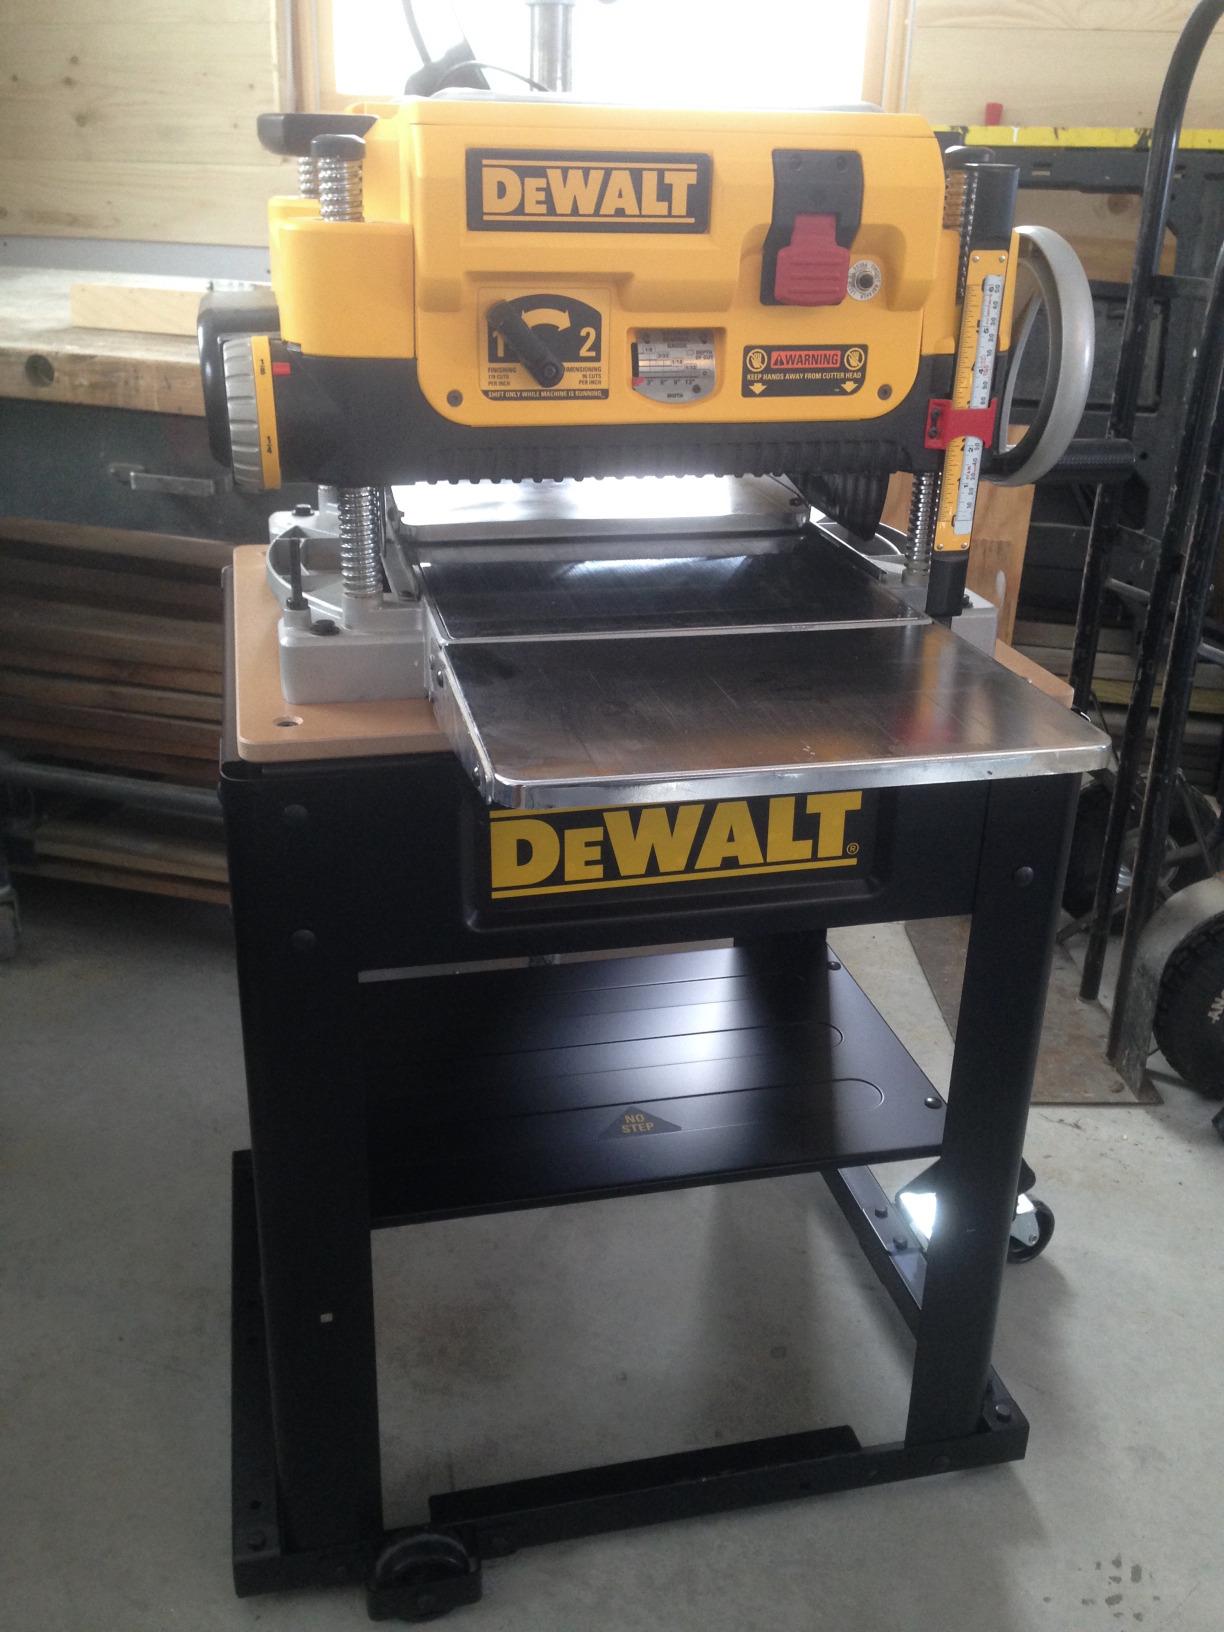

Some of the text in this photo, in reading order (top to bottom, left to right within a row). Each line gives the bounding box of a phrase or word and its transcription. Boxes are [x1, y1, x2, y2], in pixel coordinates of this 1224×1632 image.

[482, 167, 698, 216] DEWALT
[492, 330, 505, 357] 1
[579, 326, 597, 357] 2
[784, 353, 839, 366] WARNING
[747, 373, 762, 381] KEEP
[804, 372, 822, 380] FROM
[845, 371, 862, 379] HEAD
[624, 1113, 645, 1123] NO
[622, 1122, 654, 1134] STEP
